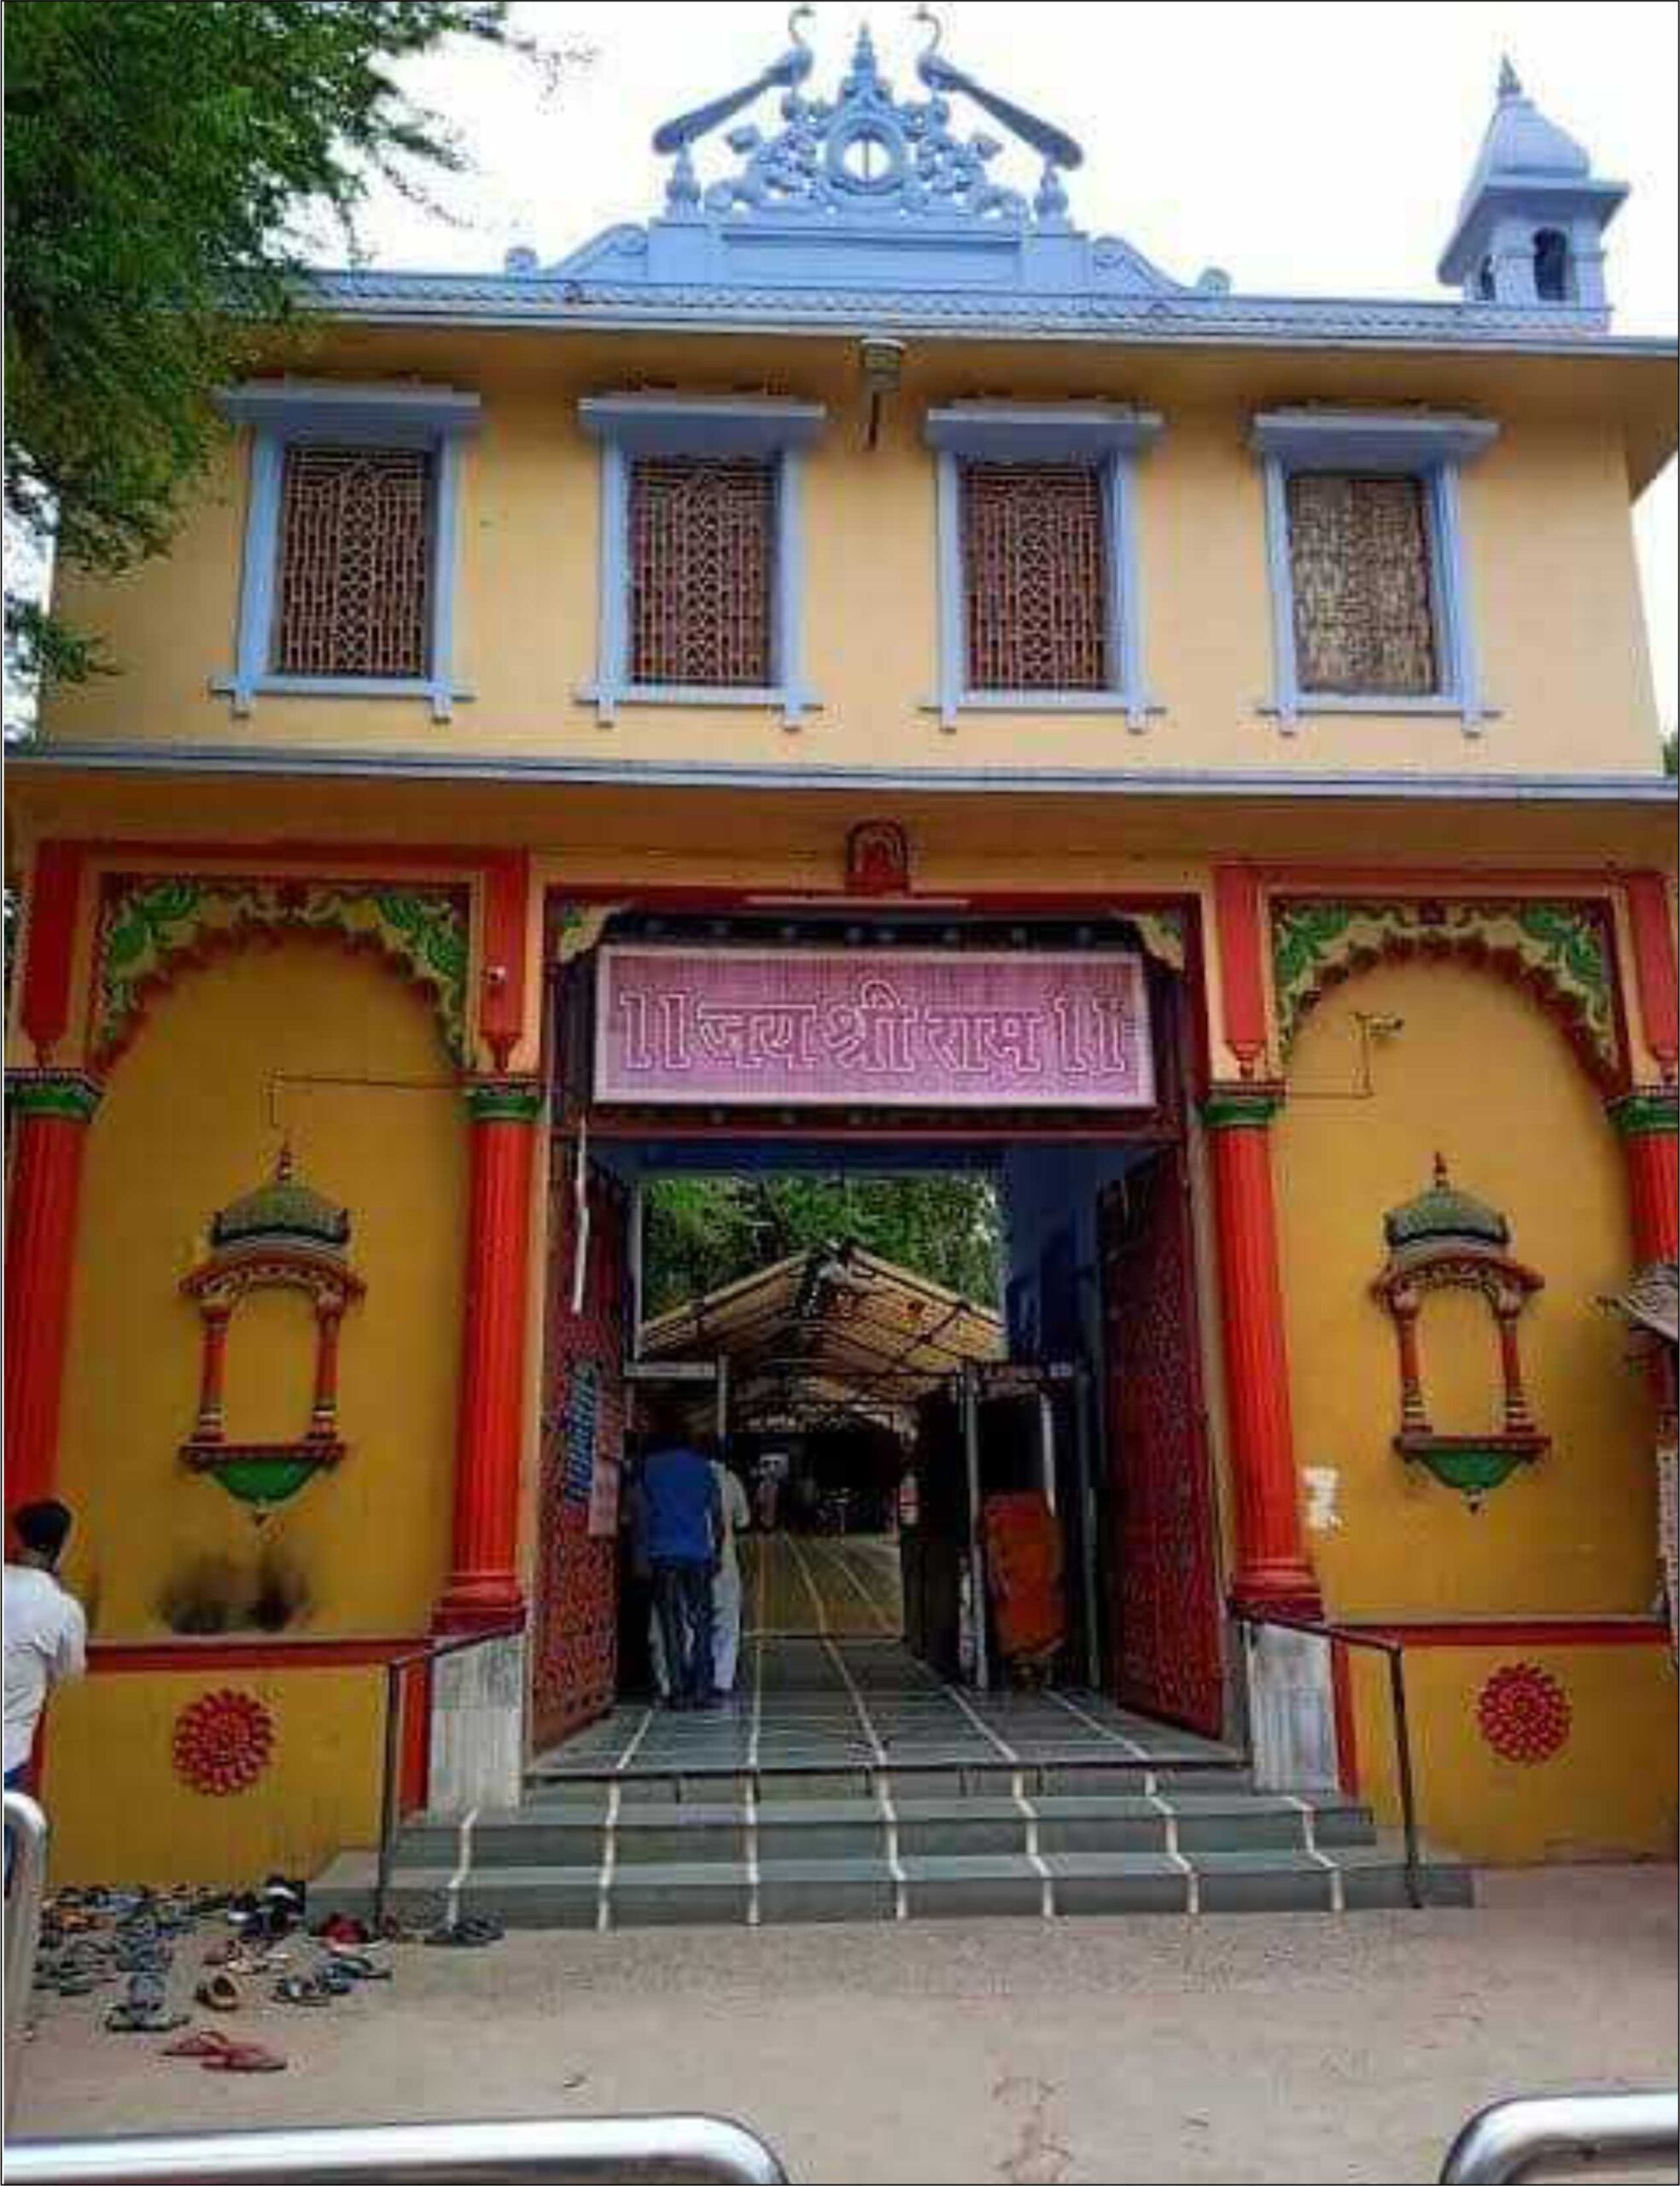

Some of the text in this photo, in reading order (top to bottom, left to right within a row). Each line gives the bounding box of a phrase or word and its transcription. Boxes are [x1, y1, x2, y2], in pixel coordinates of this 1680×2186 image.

[696, 1002, 819, 1070] जय
[821, 979, 917, 1073] श्री
[925, 1010, 1045, 1073] राम
